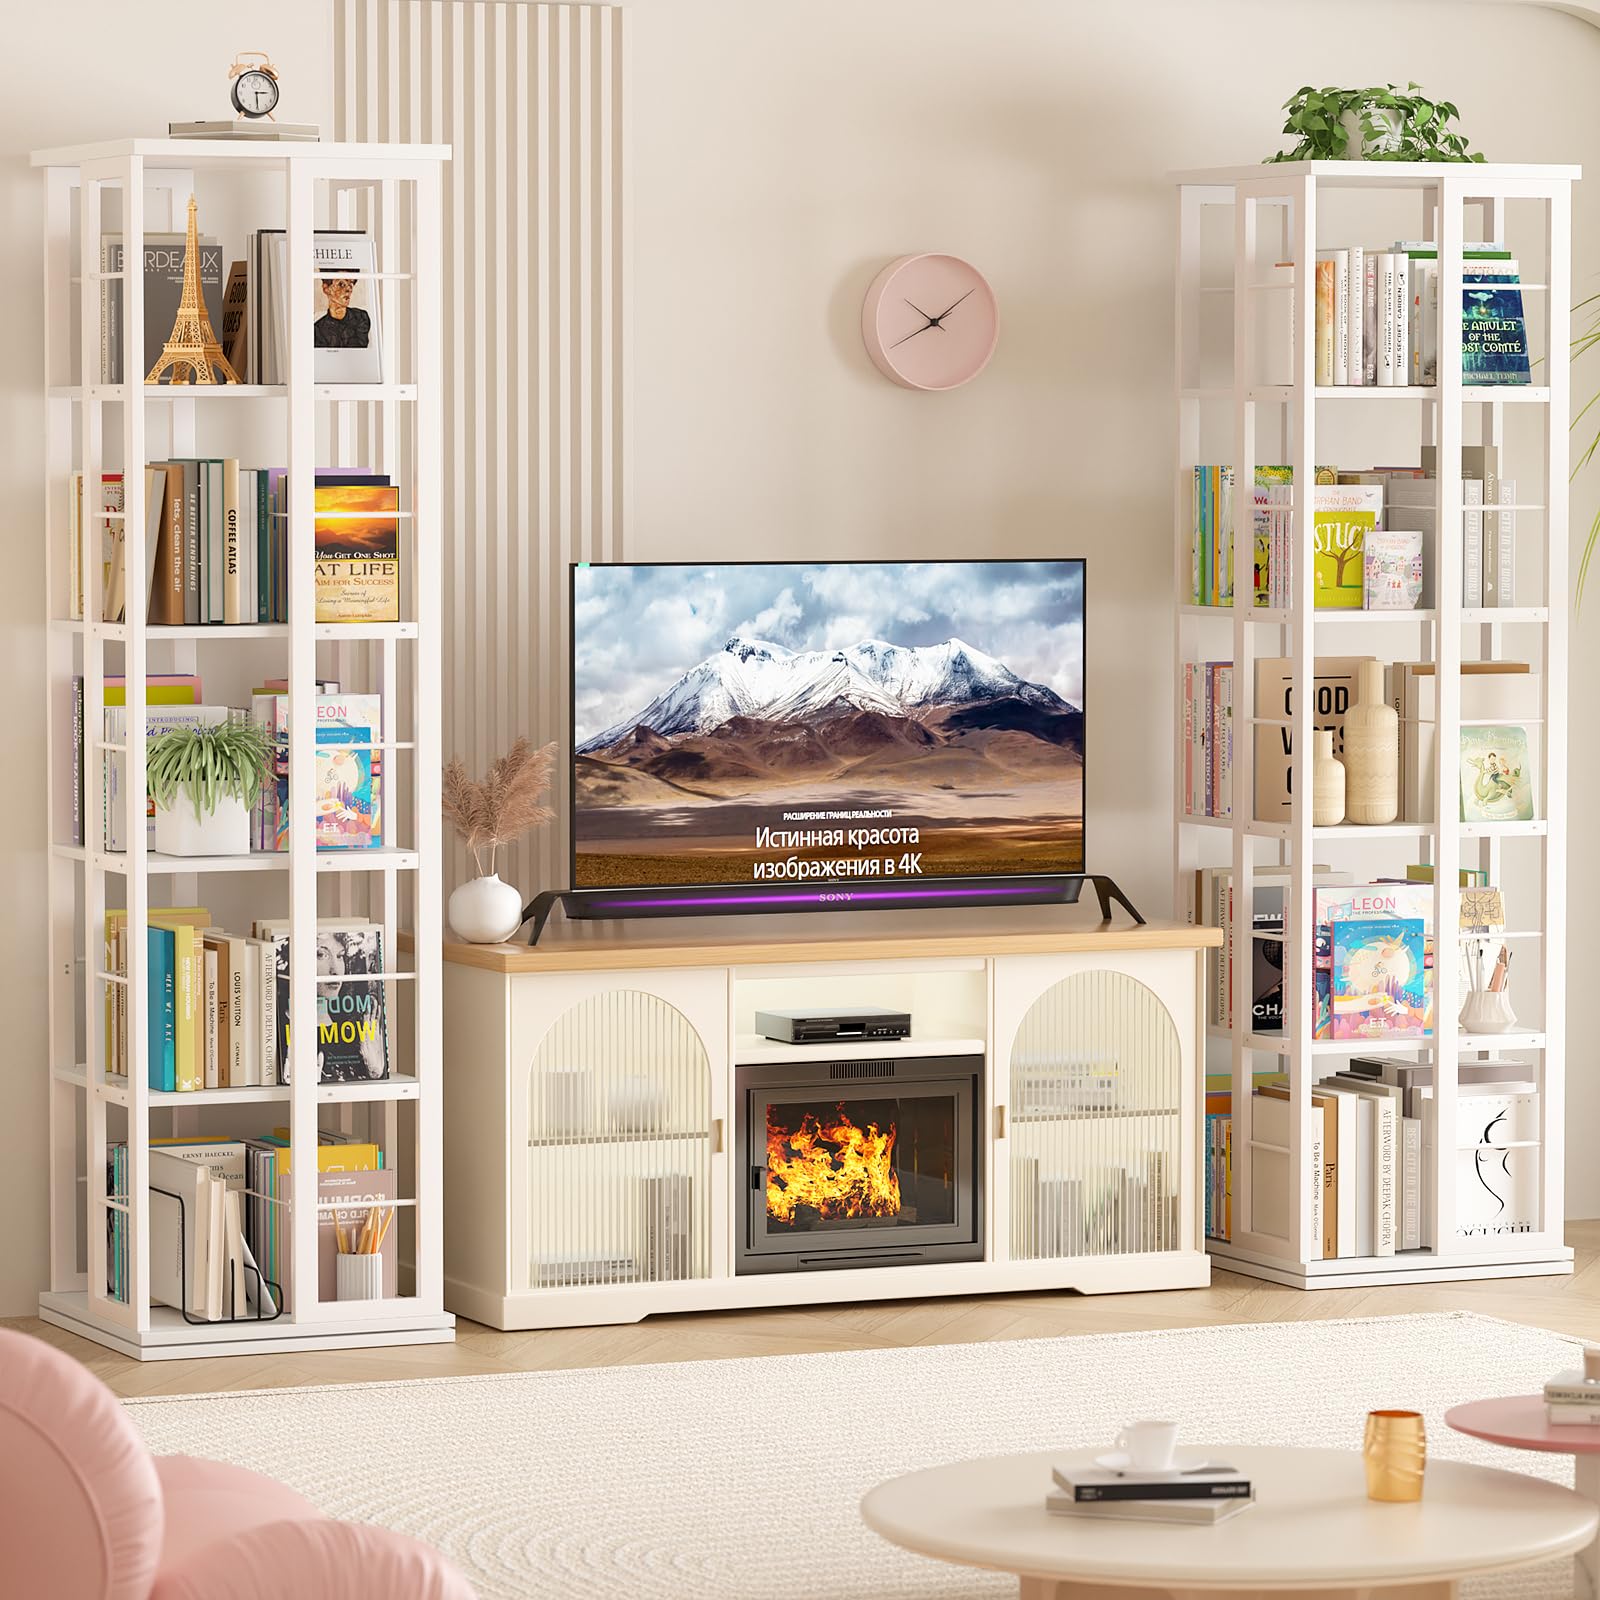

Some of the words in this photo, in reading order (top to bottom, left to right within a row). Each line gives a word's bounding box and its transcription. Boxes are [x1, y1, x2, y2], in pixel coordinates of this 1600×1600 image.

[314, 249, 353, 260] HIELE
[1471, 321, 1517, 332] AMULET
[1468, 333, 1480, 341] OF
[1462, 342, 1480, 353] OST
[1482, 340, 1522, 354] COMTÉ
[1467, 486, 1479, 506] BES
[1501, 485, 1512, 506] BES
[173, 498, 181, 522] lets,
[228, 509, 237, 543] COFFEE
[228, 546, 237, 575] ATLAS
[353, 551, 371, 559] ONE
[373, 551, 395, 559] SHOT
[315, 563, 341, 576] AT
[349, 563, 395, 576] LIFE
[353, 577, 395, 586] SUCCESS
[316, 705, 347, 718] EON
[783, 812, 826, 820] РАСШИРЕНИЕ
[826, 811, 852, 820] ГРАНИЦ
[852, 809, 892, 819] РЕАЛЬНОСТИ
[755, 826, 844, 848] Истинная
[848, 827, 920, 850] красота
[753, 856, 880, 880] изображения
[884, 858, 895, 875] в
[819, 892, 853, 902] SONY
[1352, 897, 1396, 910] LEON
[265, 953, 273, 1002] AFTERWORD
[209, 981, 215, 989] To
[209, 990, 215, 1001] Be
[219, 1001, 228, 1024] Paris
[265, 1003, 273, 1013] BY
[1252, 1004, 1286, 1016] CHA
[265, 1014, 273, 1044] DEEPAK
[265, 1045, 273, 1077] CHOPRA
[1382, 1109, 1391, 1164] AFTERWORD
[1406, 1127, 1417, 1149] BEST
[1314, 1141, 1320, 1150] To
[1314, 1151, 1320, 1162] Be
[218, 1172, 244, 1180] Ocean
[1325, 1163, 1335, 1189] Paris
[1382, 1164, 1390, 1176] BY
[1382, 1177, 1390, 1210] DEEPAK
[1406, 1188, 1417, 1206] THE
[1382, 1211, 1390, 1247] CHOPRA
[1406, 1208, 1417, 1241] WORLD
